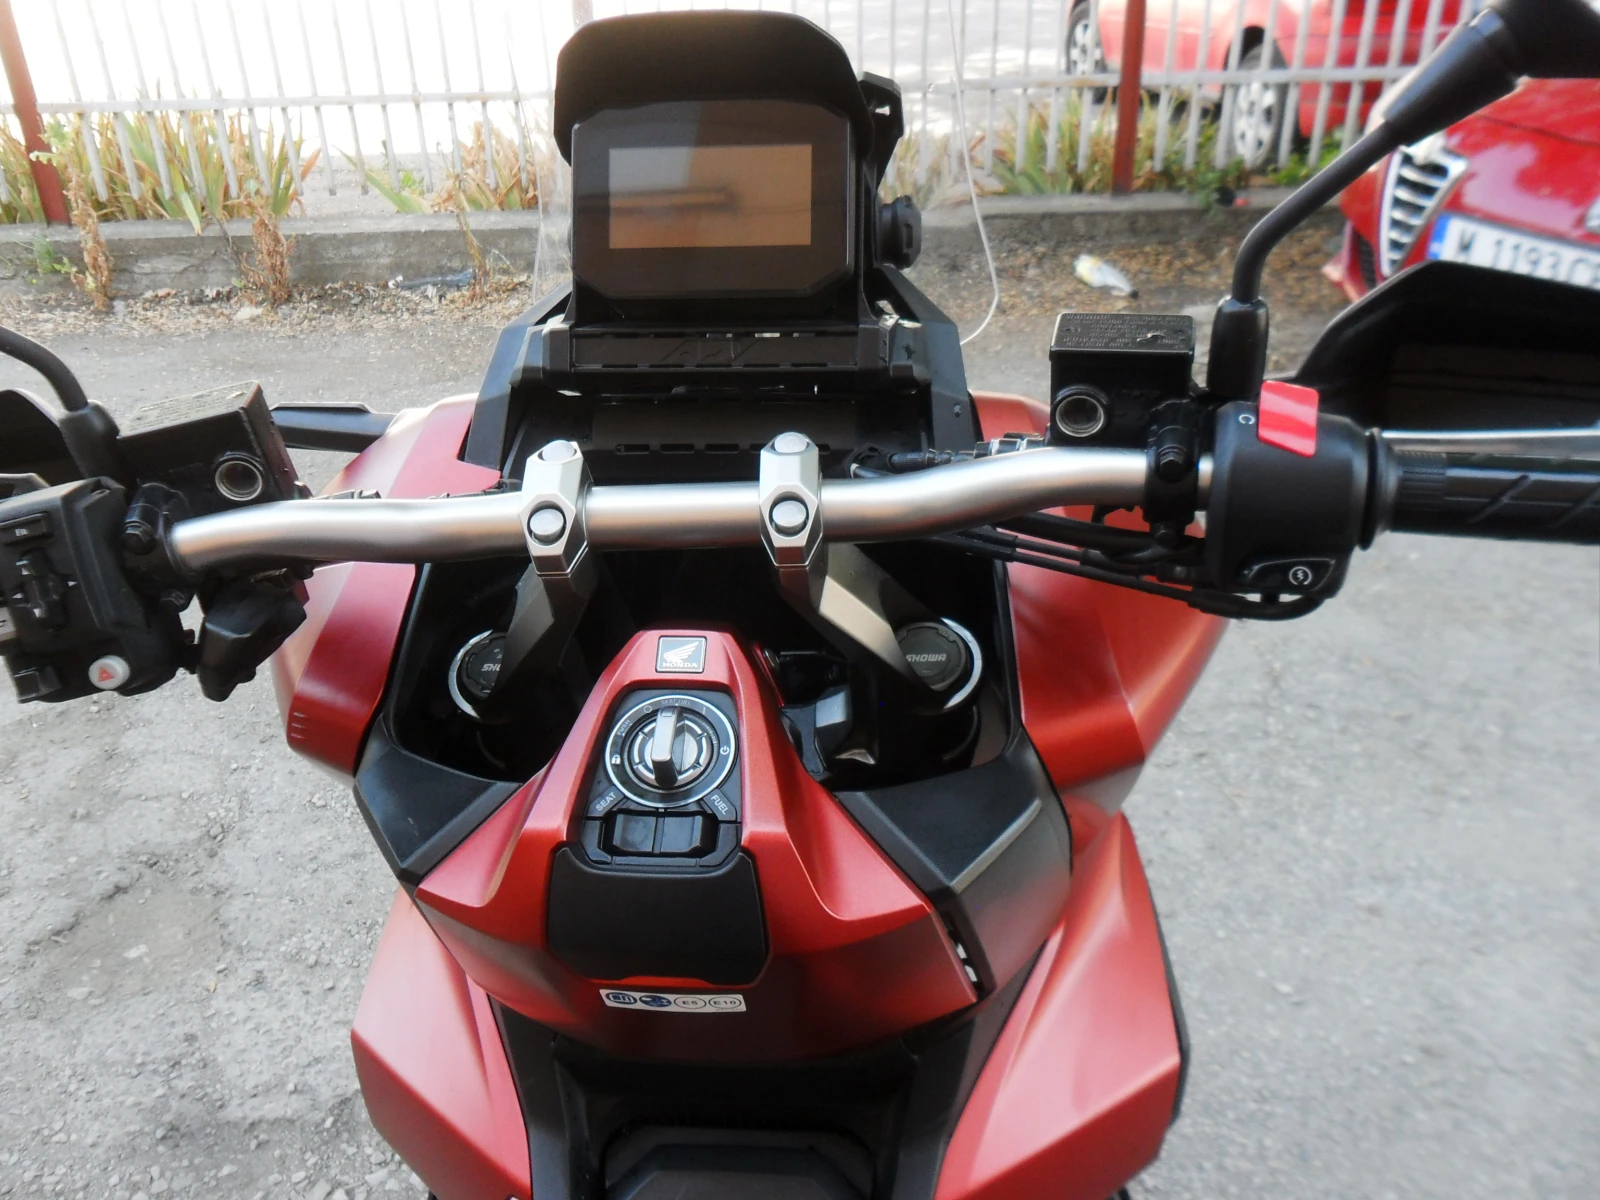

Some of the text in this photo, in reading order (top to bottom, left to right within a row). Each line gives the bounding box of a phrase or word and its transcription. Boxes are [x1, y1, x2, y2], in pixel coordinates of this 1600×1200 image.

[906, 653, 947, 662] SHOWA
[595, 791, 616, 812] SEAT
[710, 794, 728, 815] FUEL
